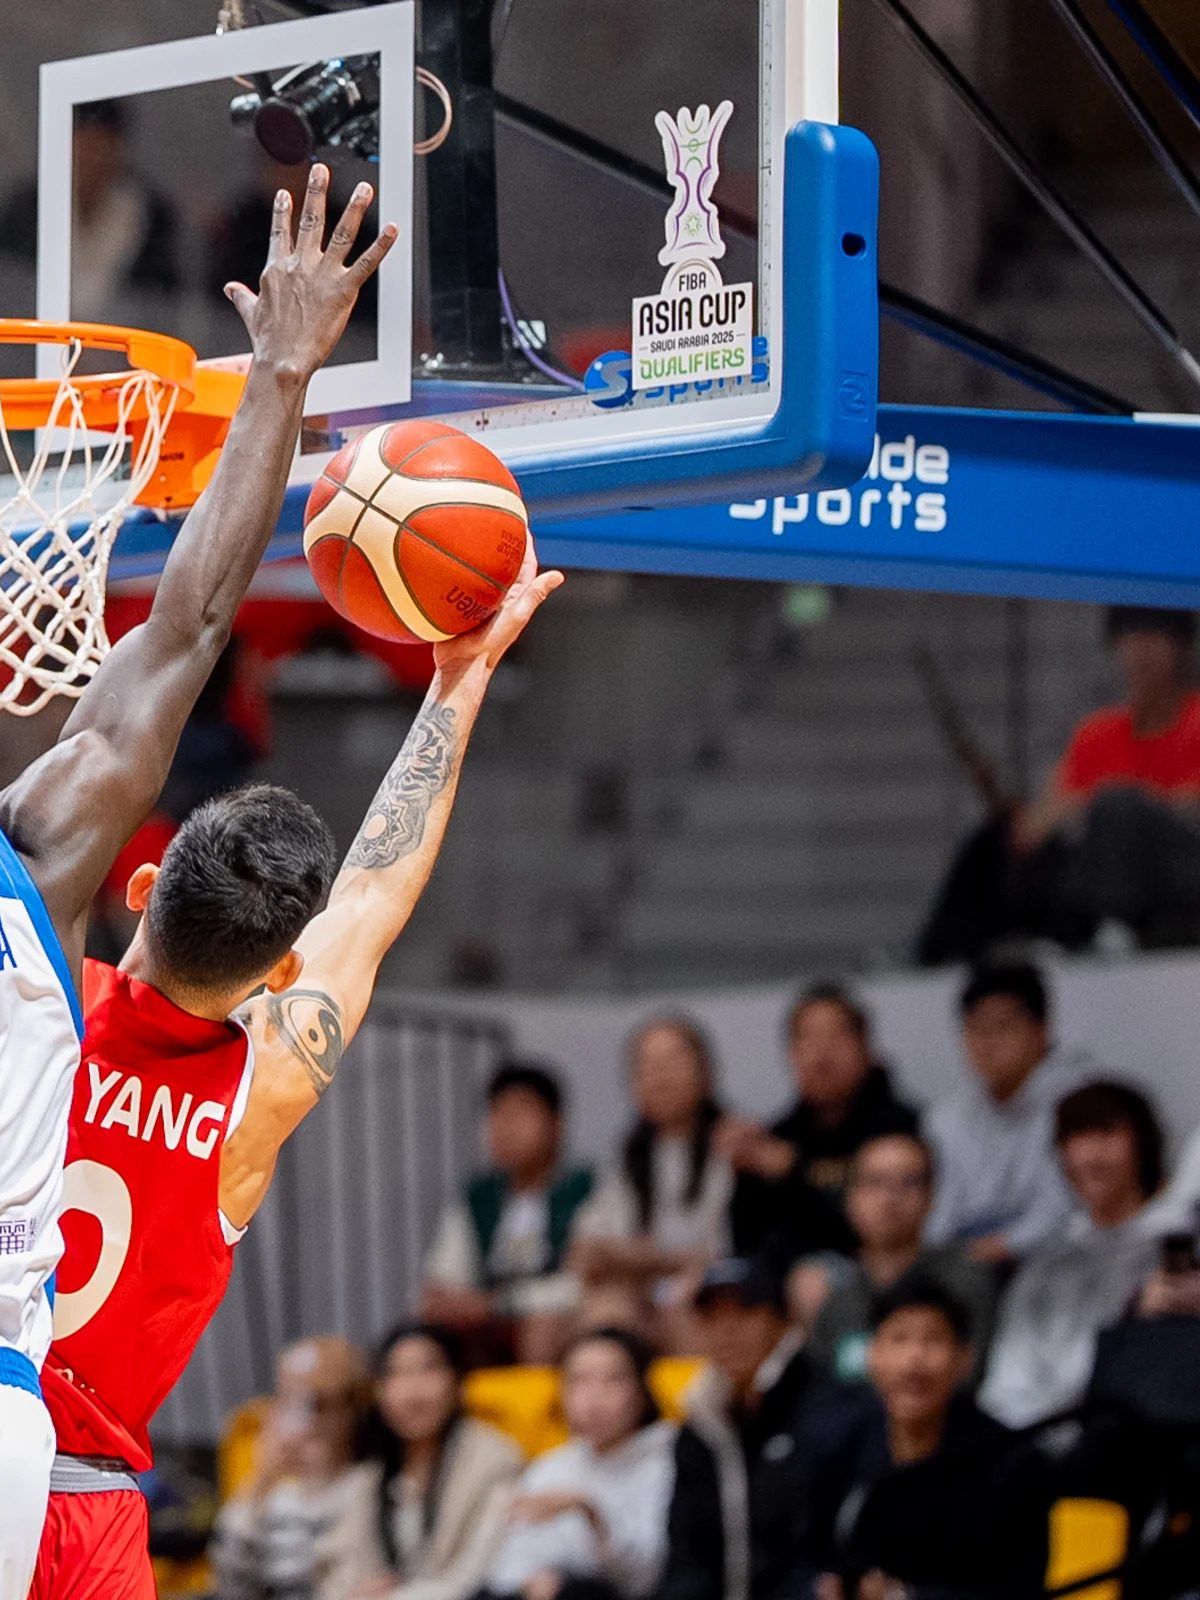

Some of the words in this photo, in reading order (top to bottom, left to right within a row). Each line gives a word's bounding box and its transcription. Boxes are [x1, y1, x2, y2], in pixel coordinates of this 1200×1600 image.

[679, 272, 707, 292] FIBA
[639, 297, 693, 337] ASIA
[699, 290, 746, 328] CUP
[650, 338, 676, 354] SAUDI
[678, 334, 710, 350] ARABIA
[711, 330, 735, 345] 2025
[639, 347, 745, 380] QUALIFIERS
[864, 432, 950, 485] lde
[84, 1061, 227, 1161] YANG
